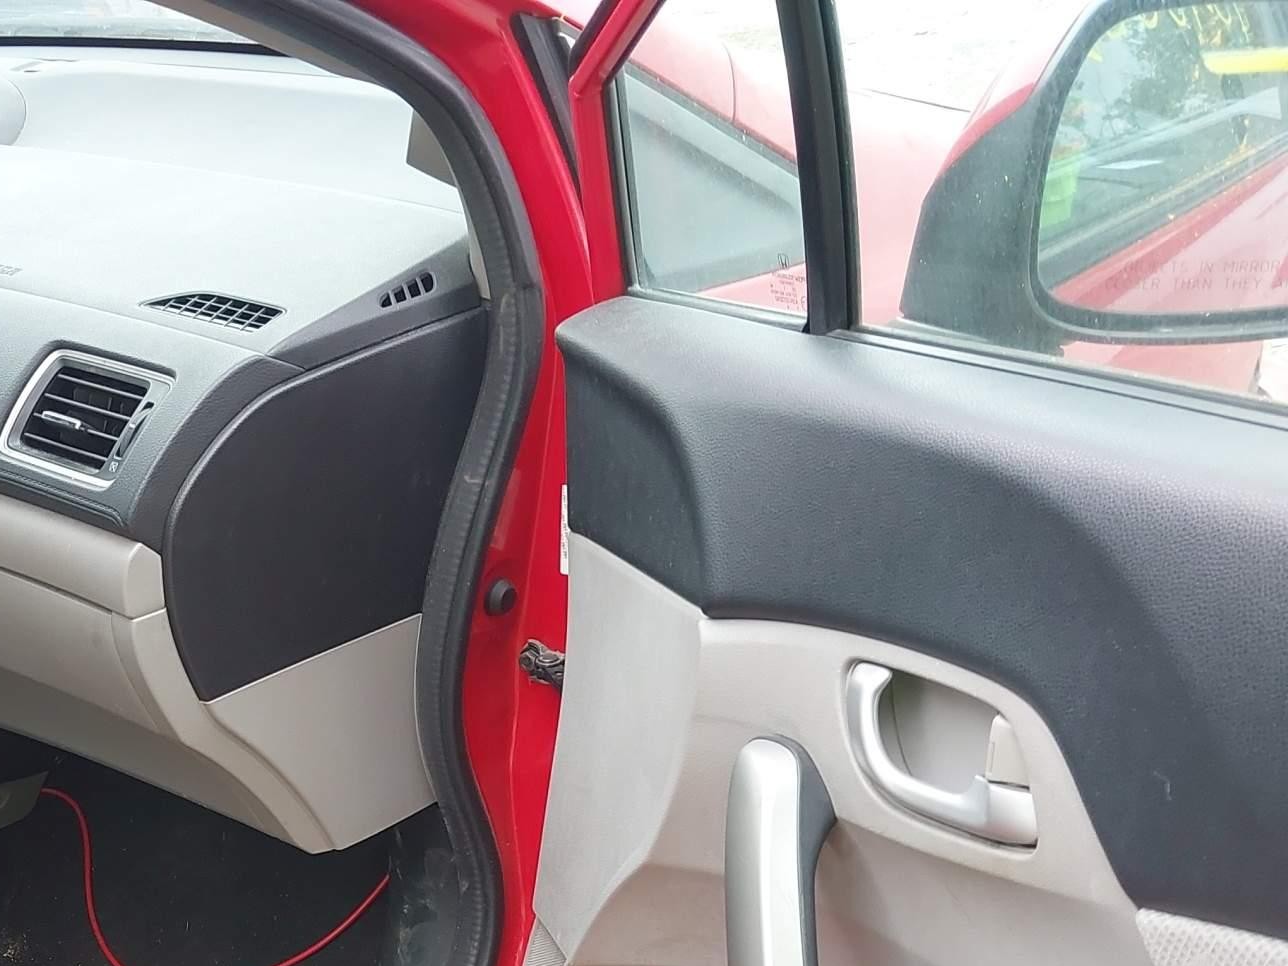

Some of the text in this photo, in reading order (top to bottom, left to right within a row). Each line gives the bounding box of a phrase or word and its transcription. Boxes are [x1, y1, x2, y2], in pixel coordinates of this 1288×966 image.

[1199, 259, 1215, 274] IN
[1173, 277, 1213, 290] THAN
[1224, 276, 1264, 290] THEY
